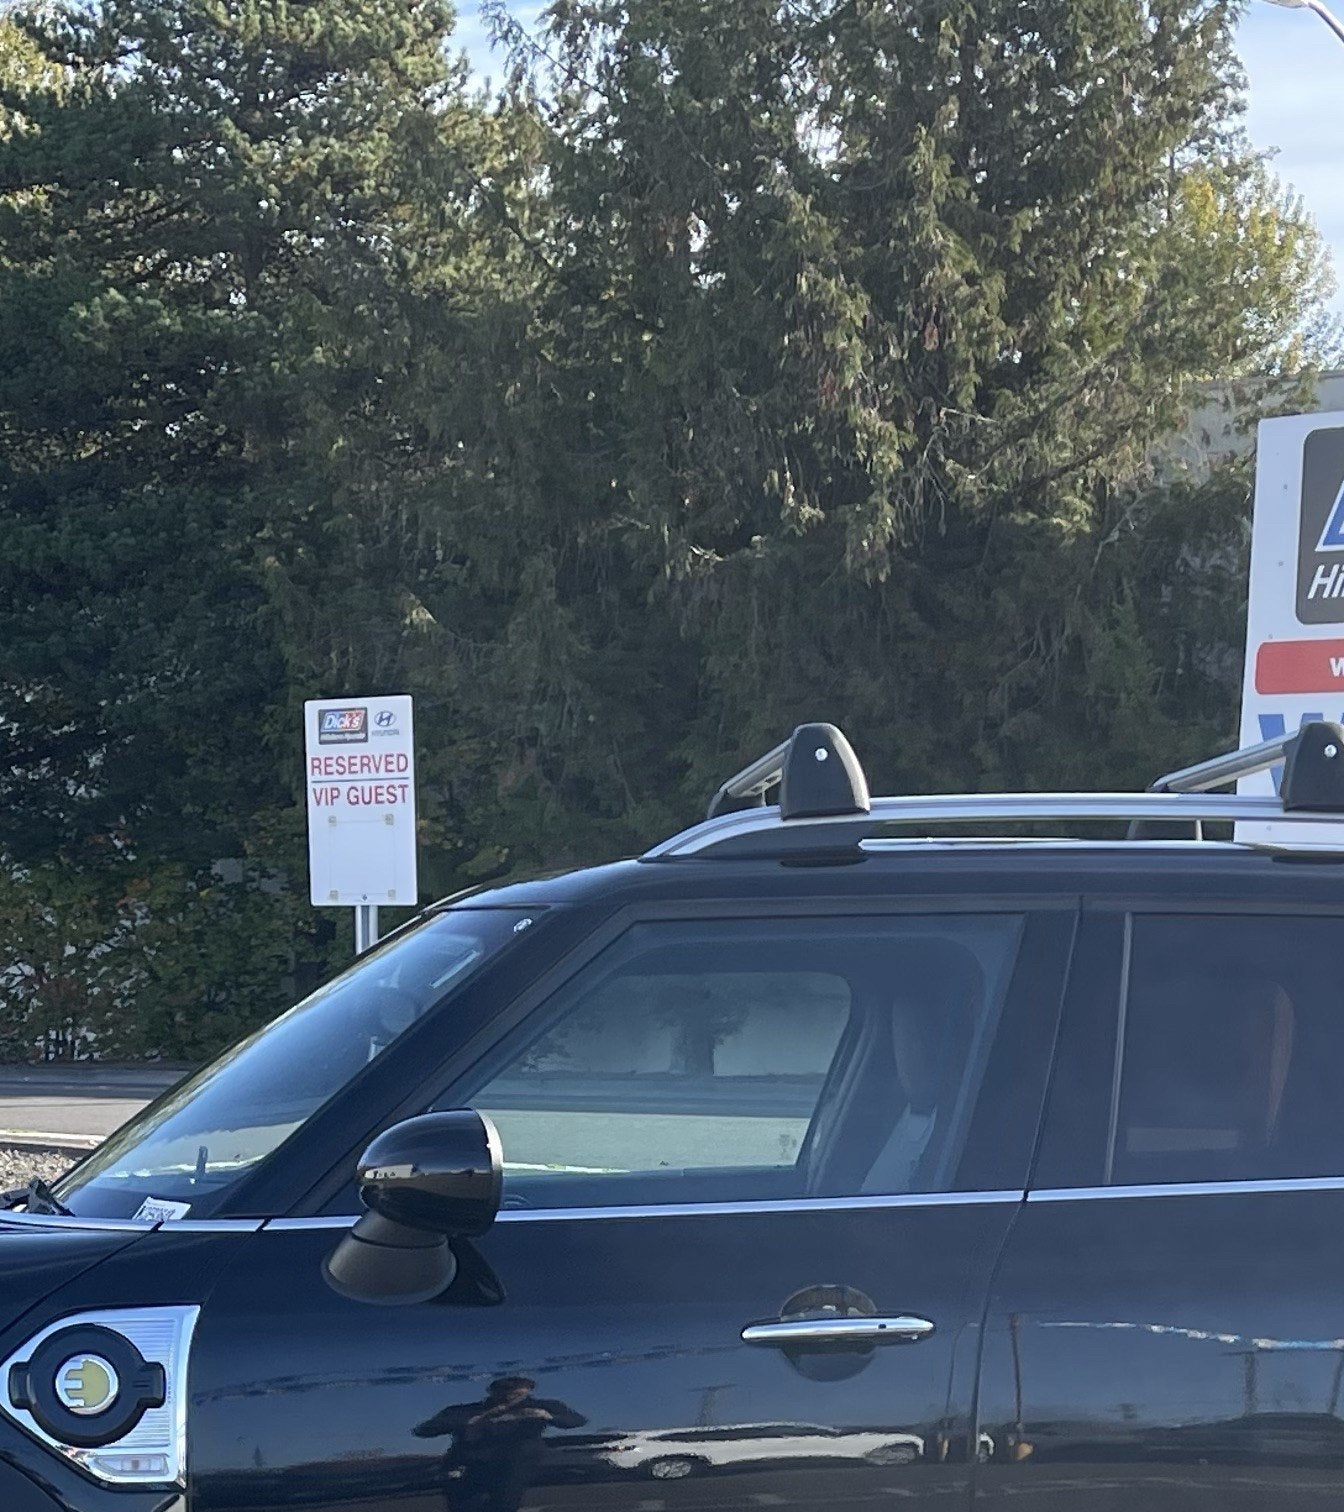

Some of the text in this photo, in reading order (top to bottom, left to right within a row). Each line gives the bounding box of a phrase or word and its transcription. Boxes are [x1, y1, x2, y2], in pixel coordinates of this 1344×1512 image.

[310, 753, 409, 776] RESERVED
[312, 783, 409, 806] VIP GUEST
